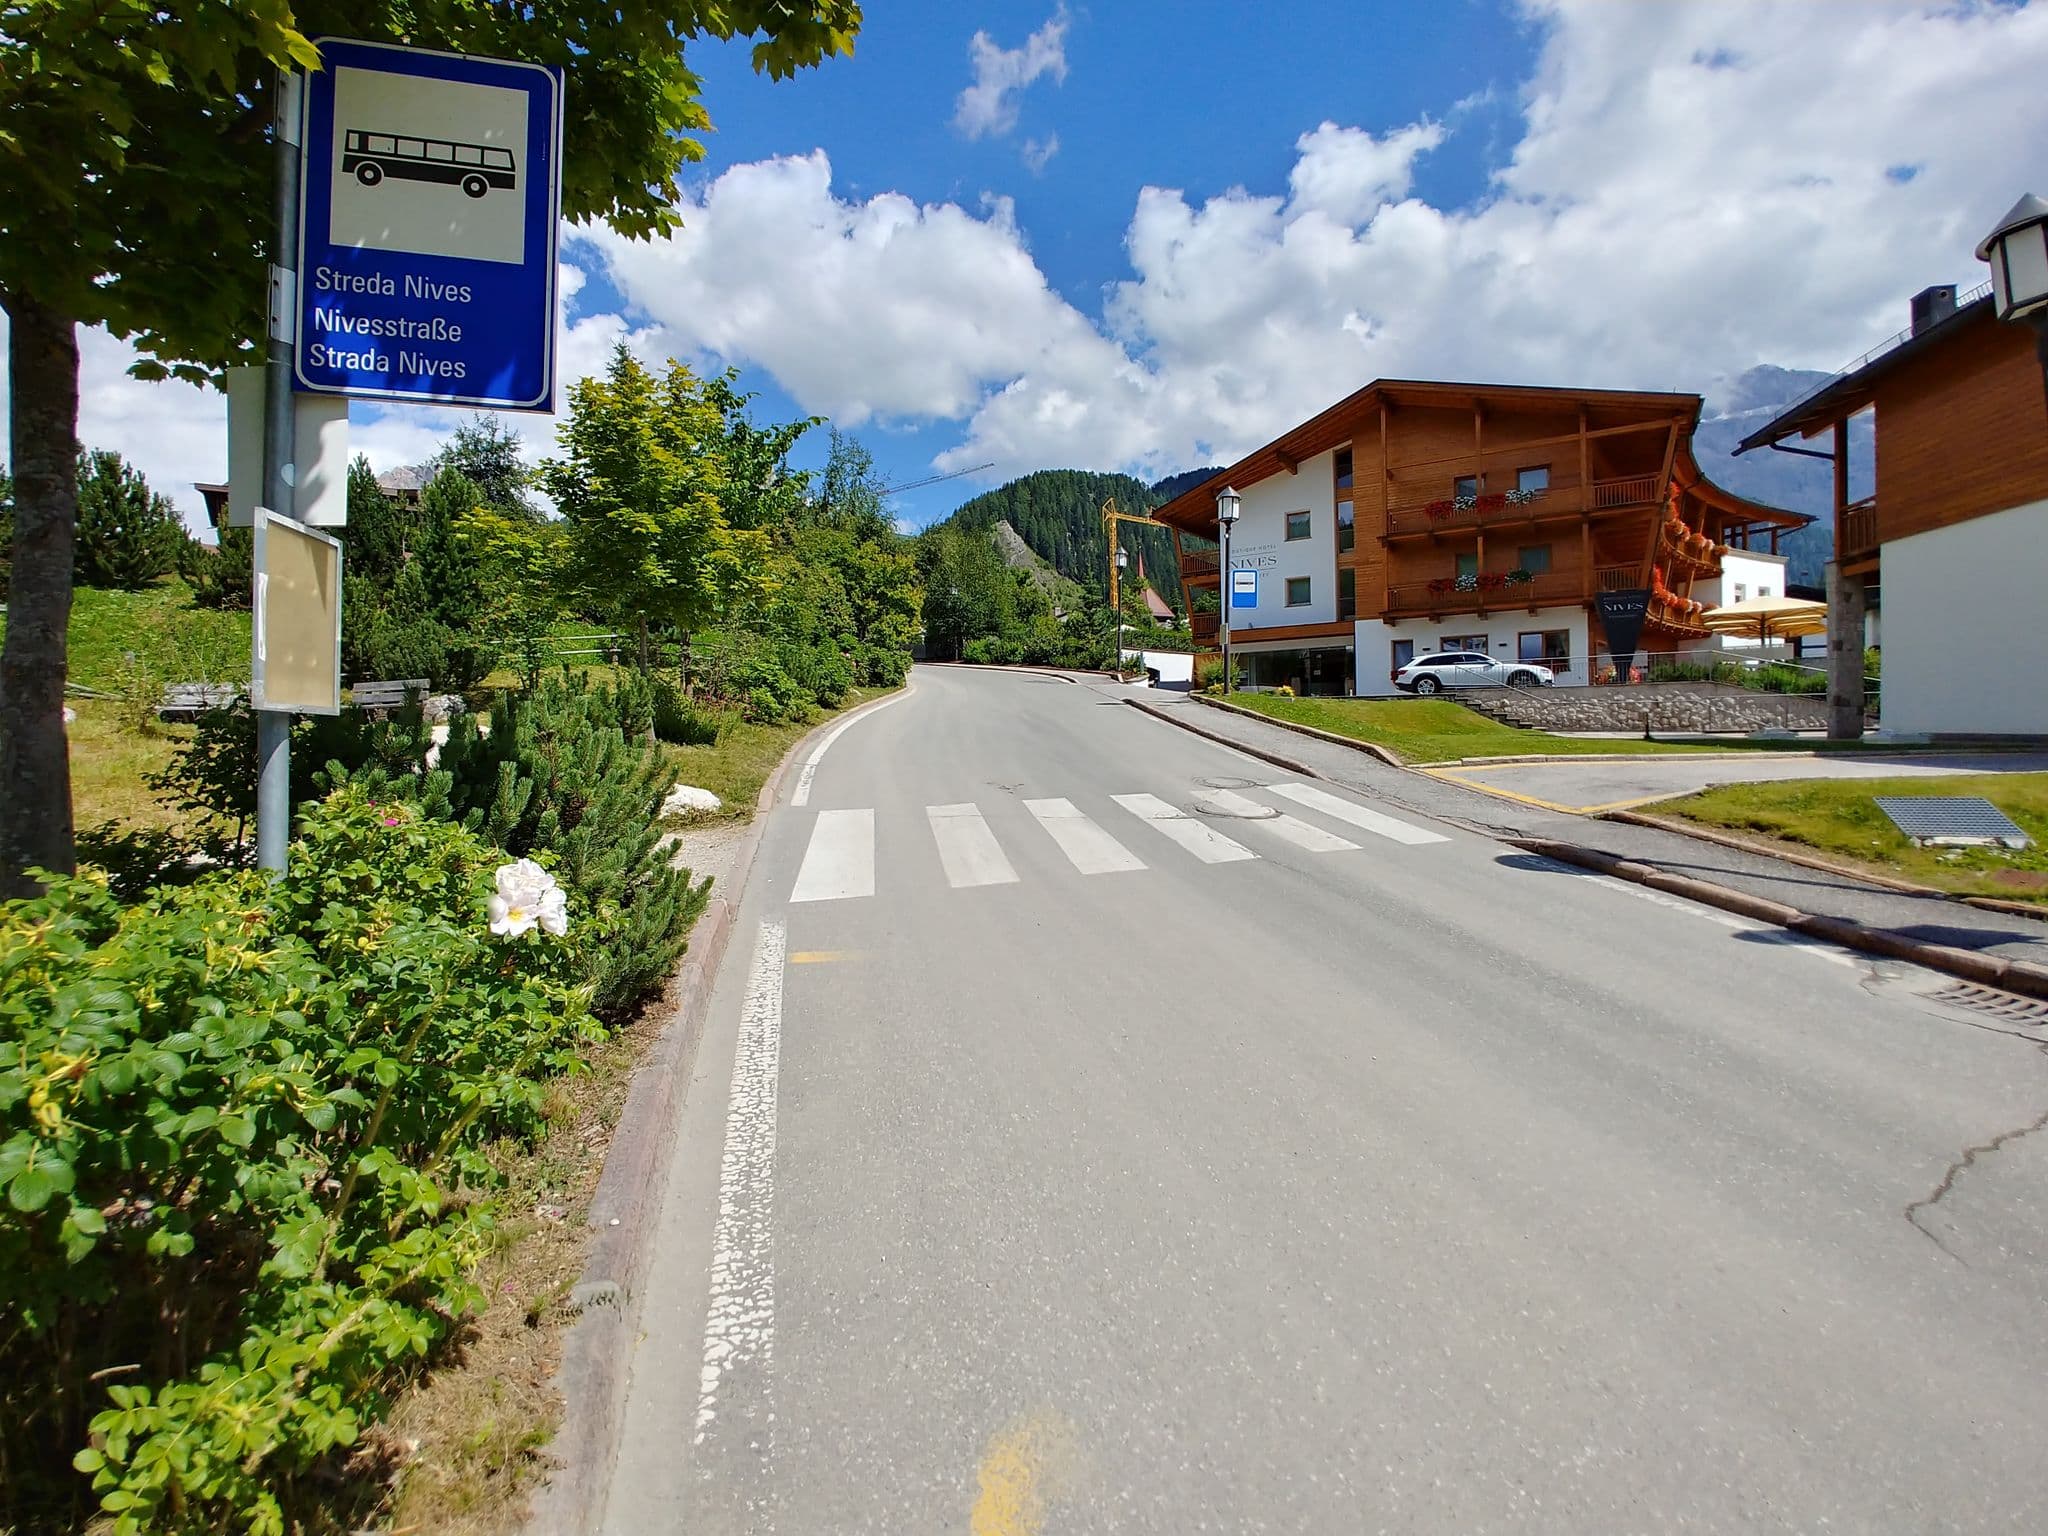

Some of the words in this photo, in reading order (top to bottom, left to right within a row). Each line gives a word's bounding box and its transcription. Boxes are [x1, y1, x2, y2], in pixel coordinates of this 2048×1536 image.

[315, 266, 395, 296] Streda
[404, 274, 472, 303] Nives
[314, 307, 462, 342] Nivesstraße
[310, 343, 389, 372] Strada
[399, 350, 466, 378] Nives
[1230, 555, 1277, 569] NIVES
[1603, 602, 1644, 612] NIVES
